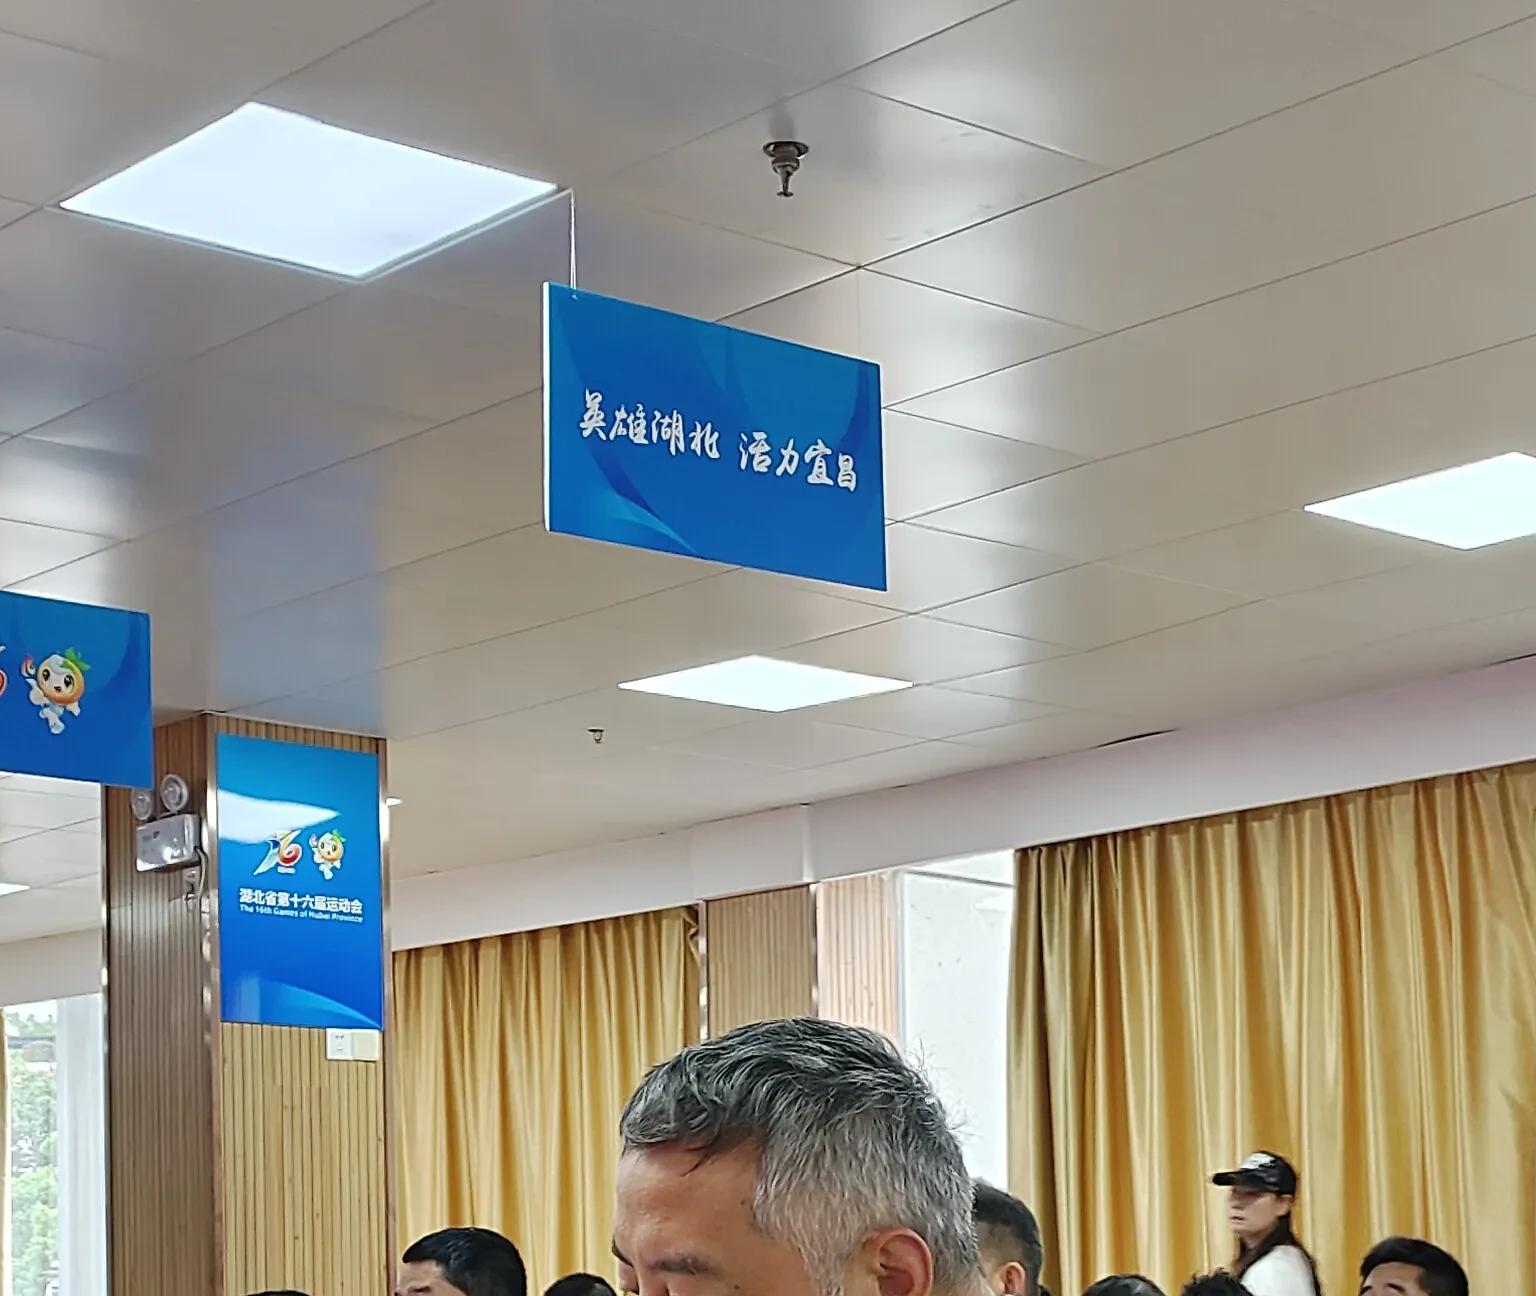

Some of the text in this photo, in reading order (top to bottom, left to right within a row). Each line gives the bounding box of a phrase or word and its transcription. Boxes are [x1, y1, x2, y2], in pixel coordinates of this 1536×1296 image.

[579, 388, 857, 492] 英雄湖北 活力宜昌
[239, 887, 363, 914] 湖北省第十六届运动会
[273, 907, 298, 918] Games
